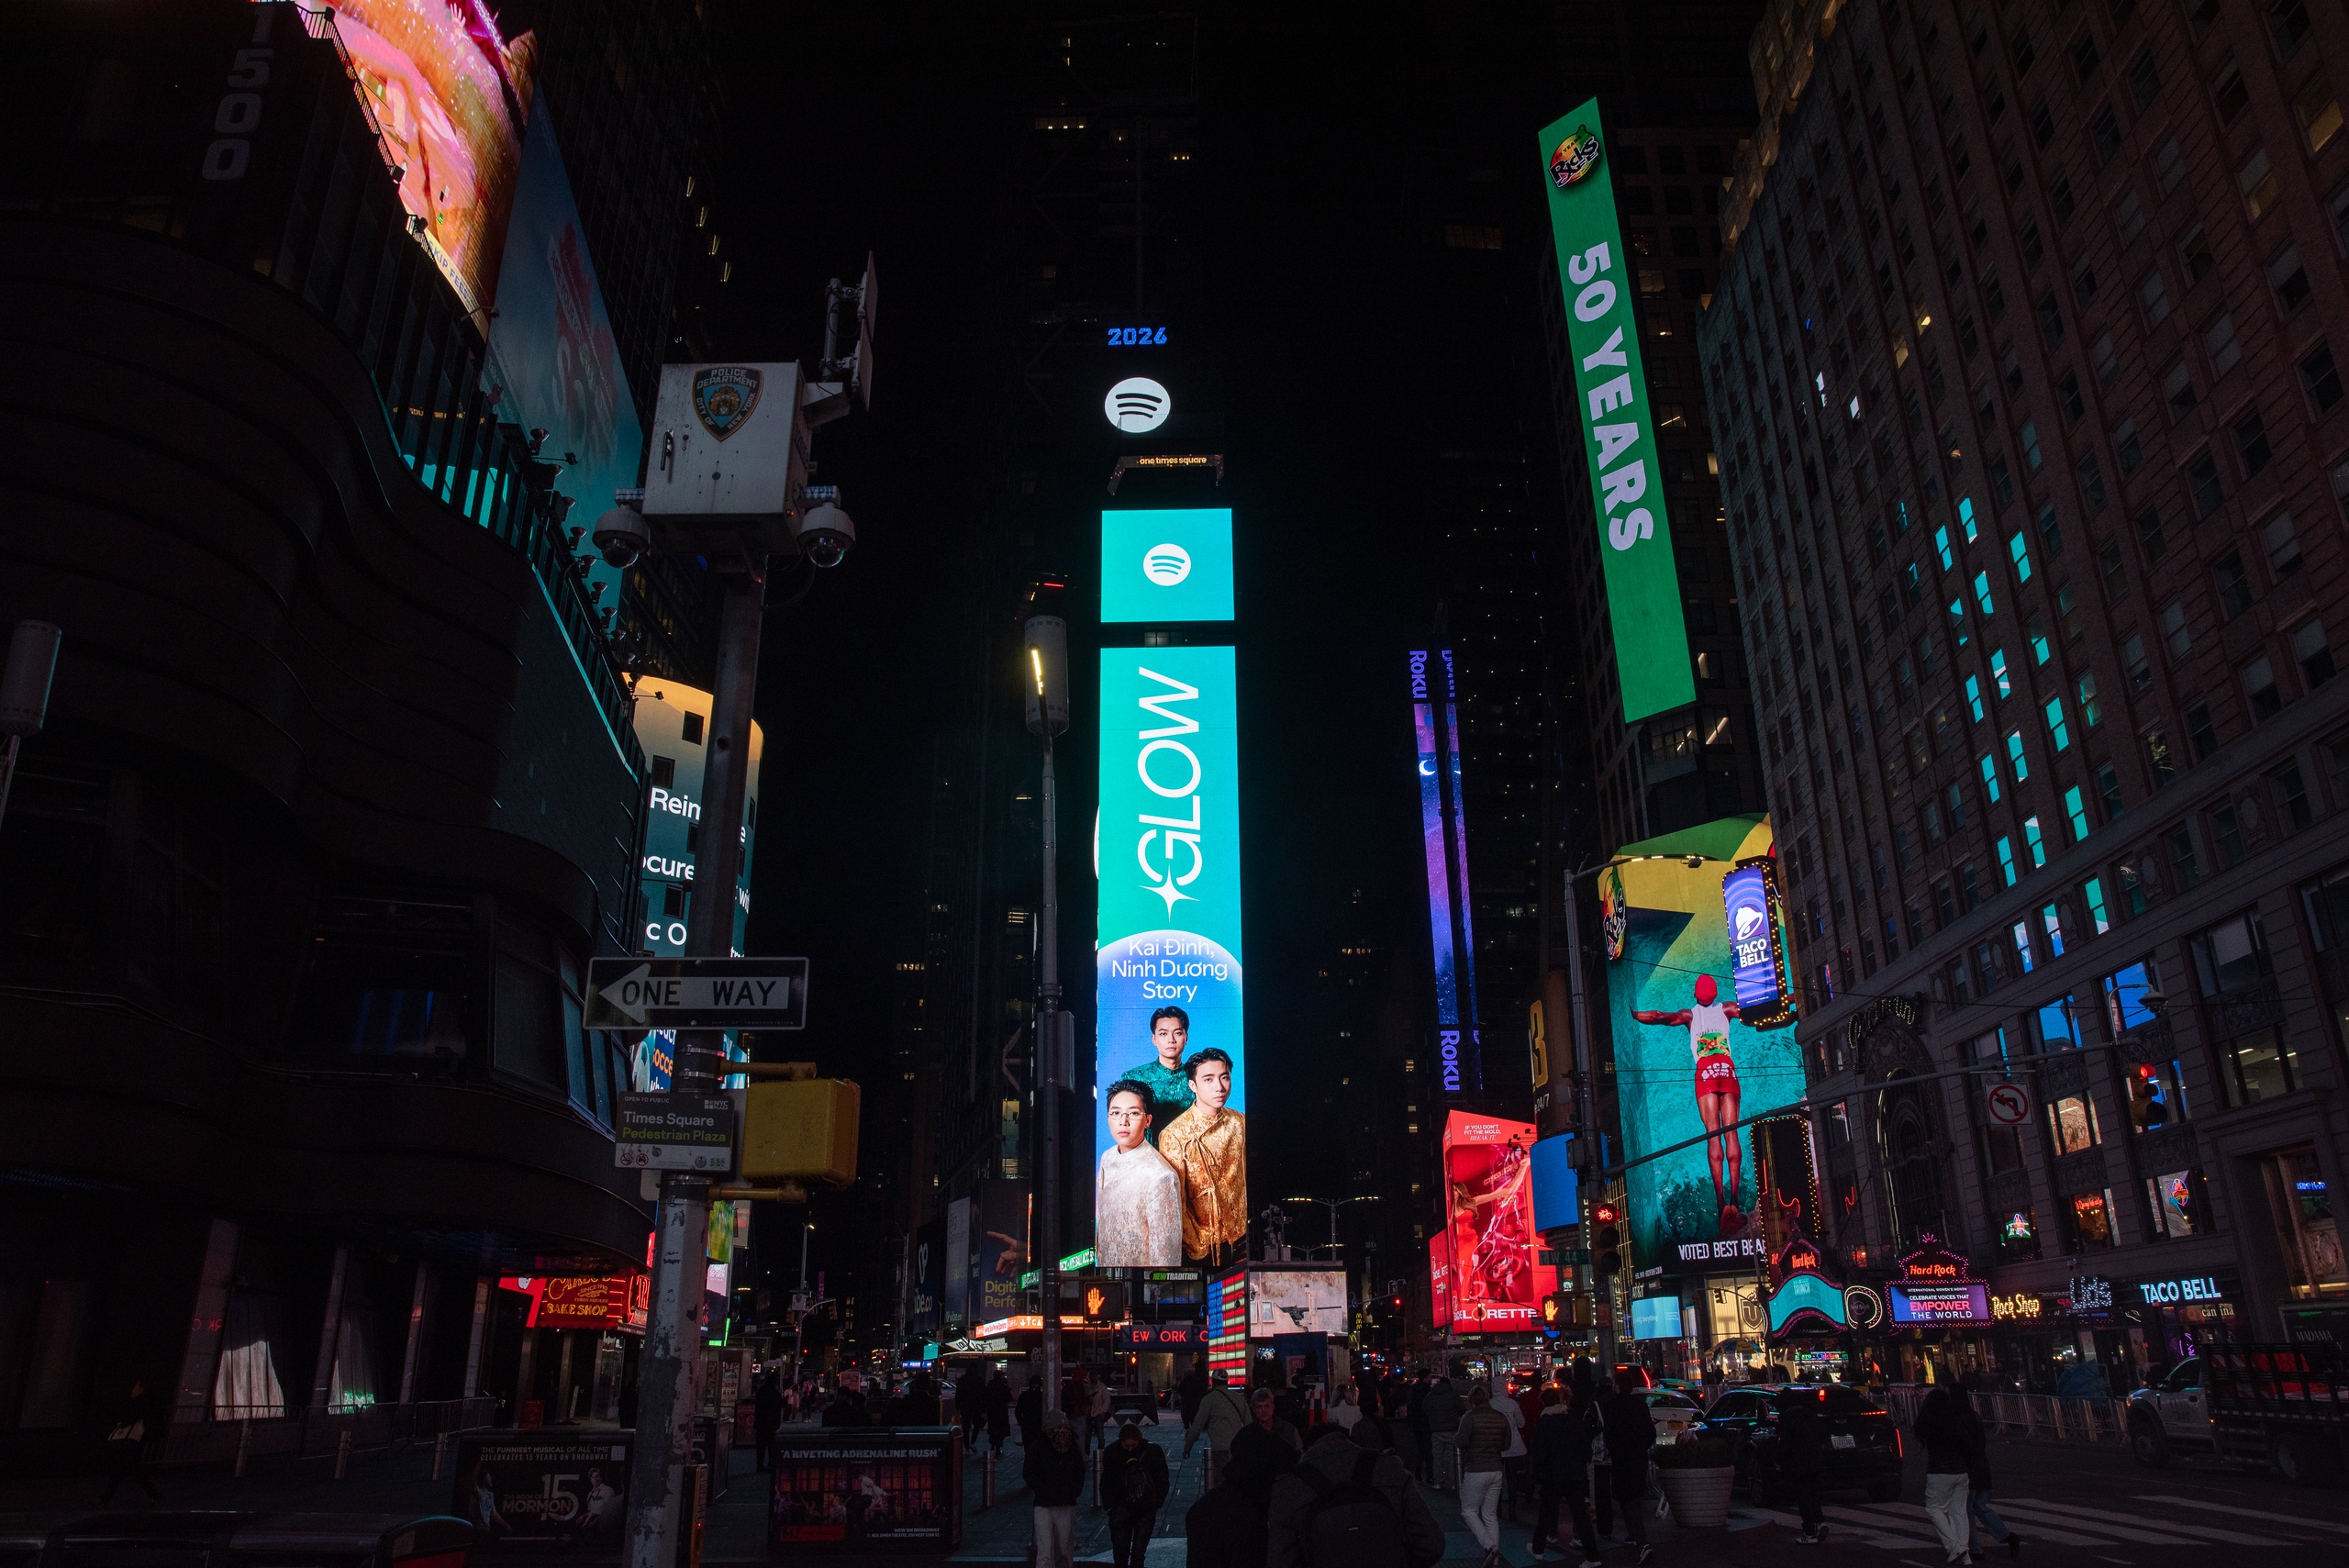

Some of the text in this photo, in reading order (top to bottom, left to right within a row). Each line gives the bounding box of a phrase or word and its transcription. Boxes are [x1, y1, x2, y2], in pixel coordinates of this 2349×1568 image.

[1108, 327, 1168, 346] 2026
[696, 375, 758, 389] DEPARTMENT
[711, 368, 748, 378] POLICE
[1568, 240, 1654, 551] 50 YEARS
[696, 397, 707, 416] CITY
[727, 413, 743, 430] NEW
[741, 392, 757, 413] YORK
[1140, 455, 1208, 466] one times square
[1137, 666, 1203, 887] GLOW
[1129, 938, 1215, 959] Kai Đinh,
[1735, 938, 1767, 957] TACO
[1739, 951, 1770, 969] BELL
[1112, 959, 1229, 982] Ninh Dương
[621, 980, 777, 1006] ONE WAY
[1142, 980, 1198, 1003] Story
[623, 1111, 715, 1128] Times Square
[622, 1127, 727, 1142] Pedestrian Plaza
[1551, 1252, 1561, 1262] W
[1564, 1251, 1577, 1262] 44
[1677, 1242, 1710, 1261] VOTED
[1713, 1240, 1739, 1258] BEST
[1792, 1251, 1817, 1270] Hard Rock
[1909, 1263, 1956, 1277] Hard Rock
[580, 1284, 596, 1293] SINCE
[2070, 1275, 2112, 1310] Lids
[2139, 1277, 2222, 1304] TACO BELL
[546, 1303, 607, 1316] BAKE SHOP
[1909, 1300, 1971, 1311] EMPOWER
[1991, 1296, 2016, 1319] Rock
[2016, 1293, 2040, 1318] Shop
[480, 1453, 609, 1462] CELEBRATES 15 YEARS ON BROADWAY
[792, 1449, 841, 1459] RIVETING
[842, 1448, 907, 1459] ADRENALINE
[502, 1499, 573, 1513] MORMON
[540, 1473, 581, 1521] 15
